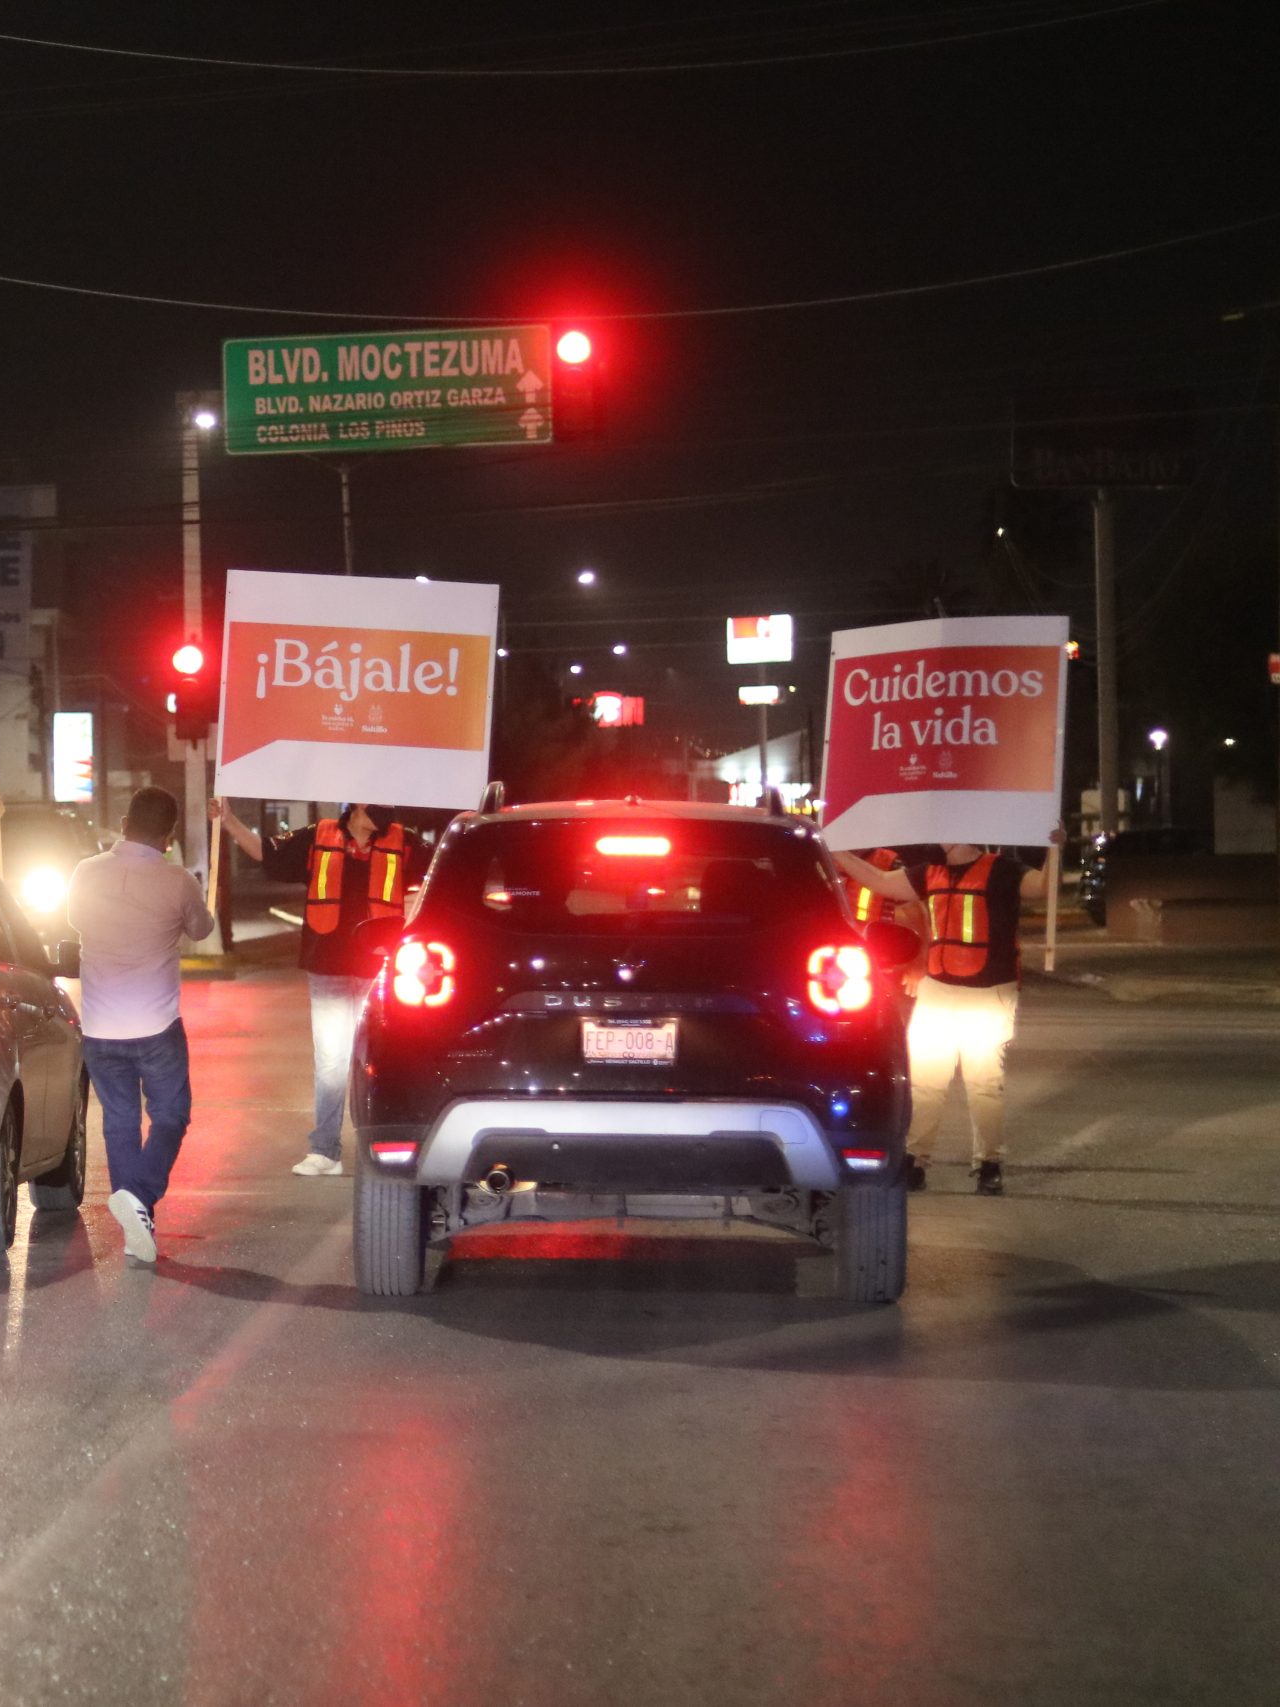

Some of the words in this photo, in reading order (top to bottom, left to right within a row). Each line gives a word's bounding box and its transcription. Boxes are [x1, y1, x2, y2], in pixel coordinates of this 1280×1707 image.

[248, 348, 328, 385] BLVD.
[338, 338, 524, 381] MOCTEZUMA
[255, 397, 304, 415] BLVD.
[308, 392, 385, 412] NAZARIO
[389, 390, 442, 409] ORTIZ
[447, 387, 506, 406] GARZA
[256, 424, 330, 443] COLONIA
[339, 422, 370, 439] LOS
[375, 419, 426, 439] PINOS
[255, 639, 459, 701] ¡Bájale!
[843, 660, 1044, 707] Cuidemos
[871, 711, 902, 751] la
[910, 704, 998, 746] vida
[586, 1031, 674, 1051] FEP-008-A
